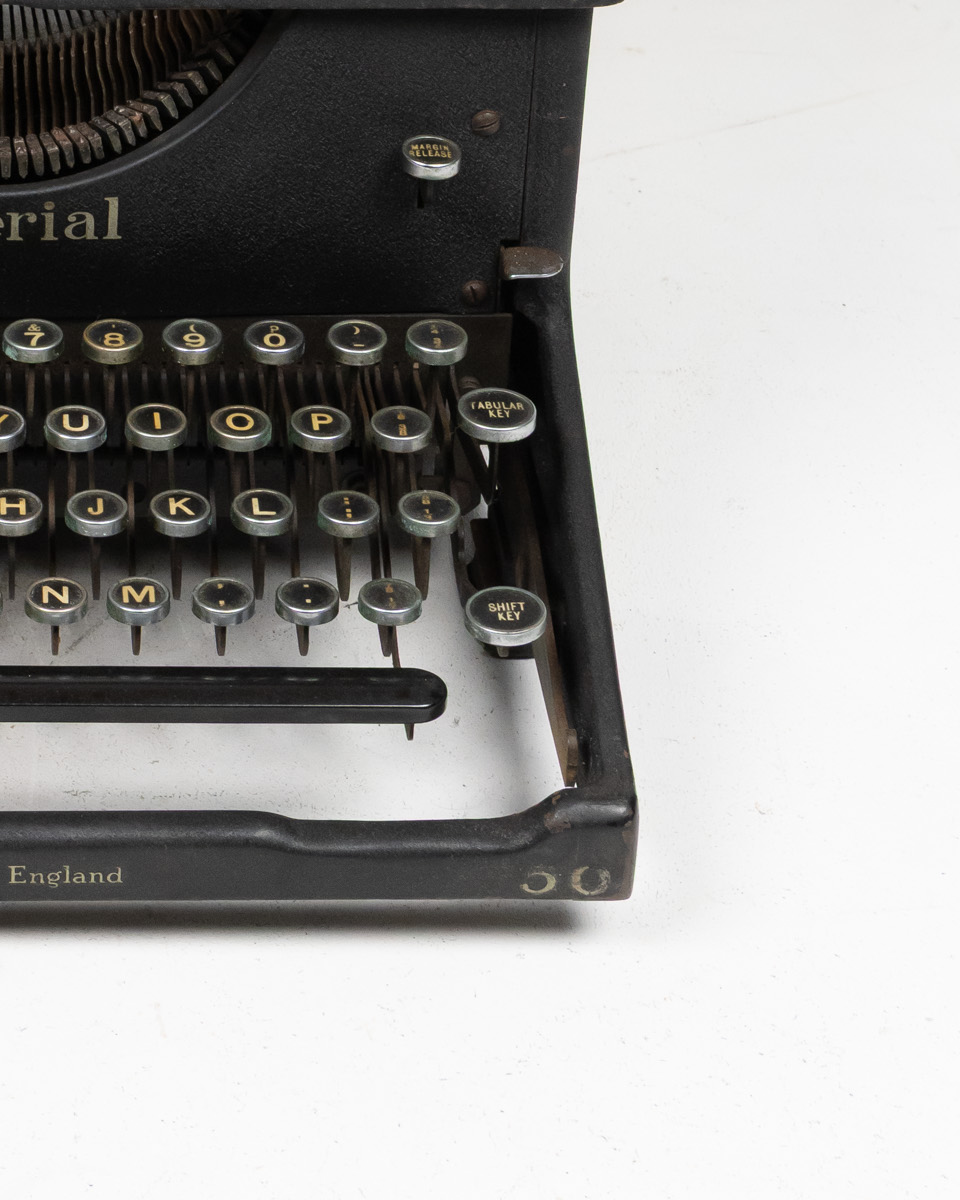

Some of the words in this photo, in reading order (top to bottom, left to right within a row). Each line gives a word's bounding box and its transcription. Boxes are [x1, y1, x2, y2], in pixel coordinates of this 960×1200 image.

[409, 150, 452, 159] RELEASE
[411, 143, 449, 151] MARGIN
[23, 332, 46, 347] 7
[103, 332, 126, 347] 8
[182, 332, 206, 348] 9
[471, 401, 524, 411] TABULAR
[489, 408, 512, 417] KEY
[62, 413, 89, 431] U
[154, 412, 161, 429] I
[225, 412, 255, 431] O
[310, 412, 334, 431] P
[0, 498, 26, 515] H
[88, 498, 103, 515] J
[169, 498, 195, 515] K
[252, 498, 276, 515] L
[42, 586, 69, 603] N
[122, 586, 155, 603] M
[488, 602, 525, 612] SHIFT
[498, 610, 520, 620] KEY
[8, 866, 122, 887] England
